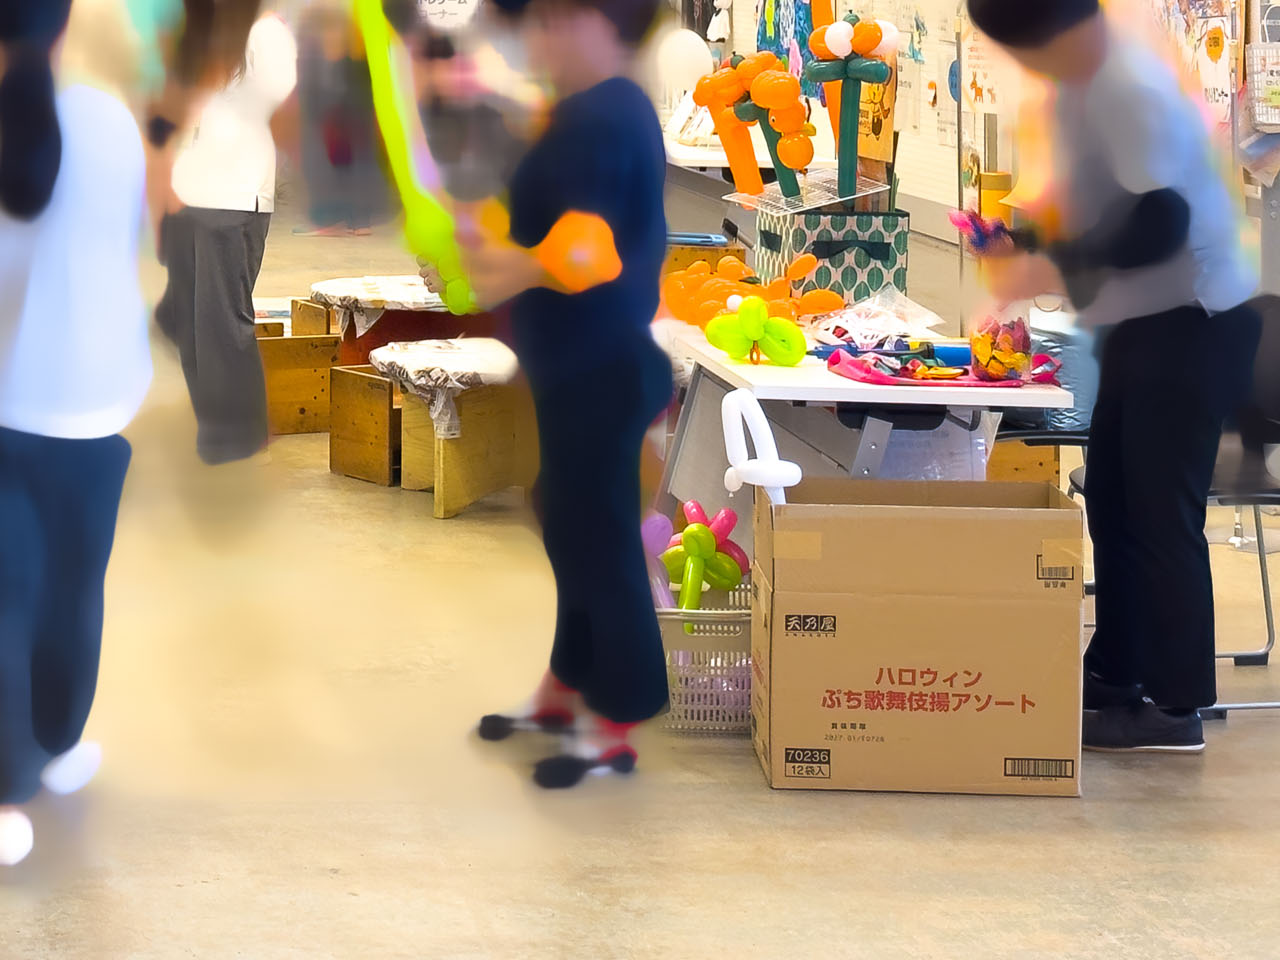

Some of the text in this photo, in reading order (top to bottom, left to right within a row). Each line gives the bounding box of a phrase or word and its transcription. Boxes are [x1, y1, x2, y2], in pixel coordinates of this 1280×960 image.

[875, 667, 982, 688] ハロウィン
[821, 689, 1036, 714] ぷち歌舞伎揚アソート
[787, 749, 829, 762] 70236
[791, 765, 825, 776] 12袋入
